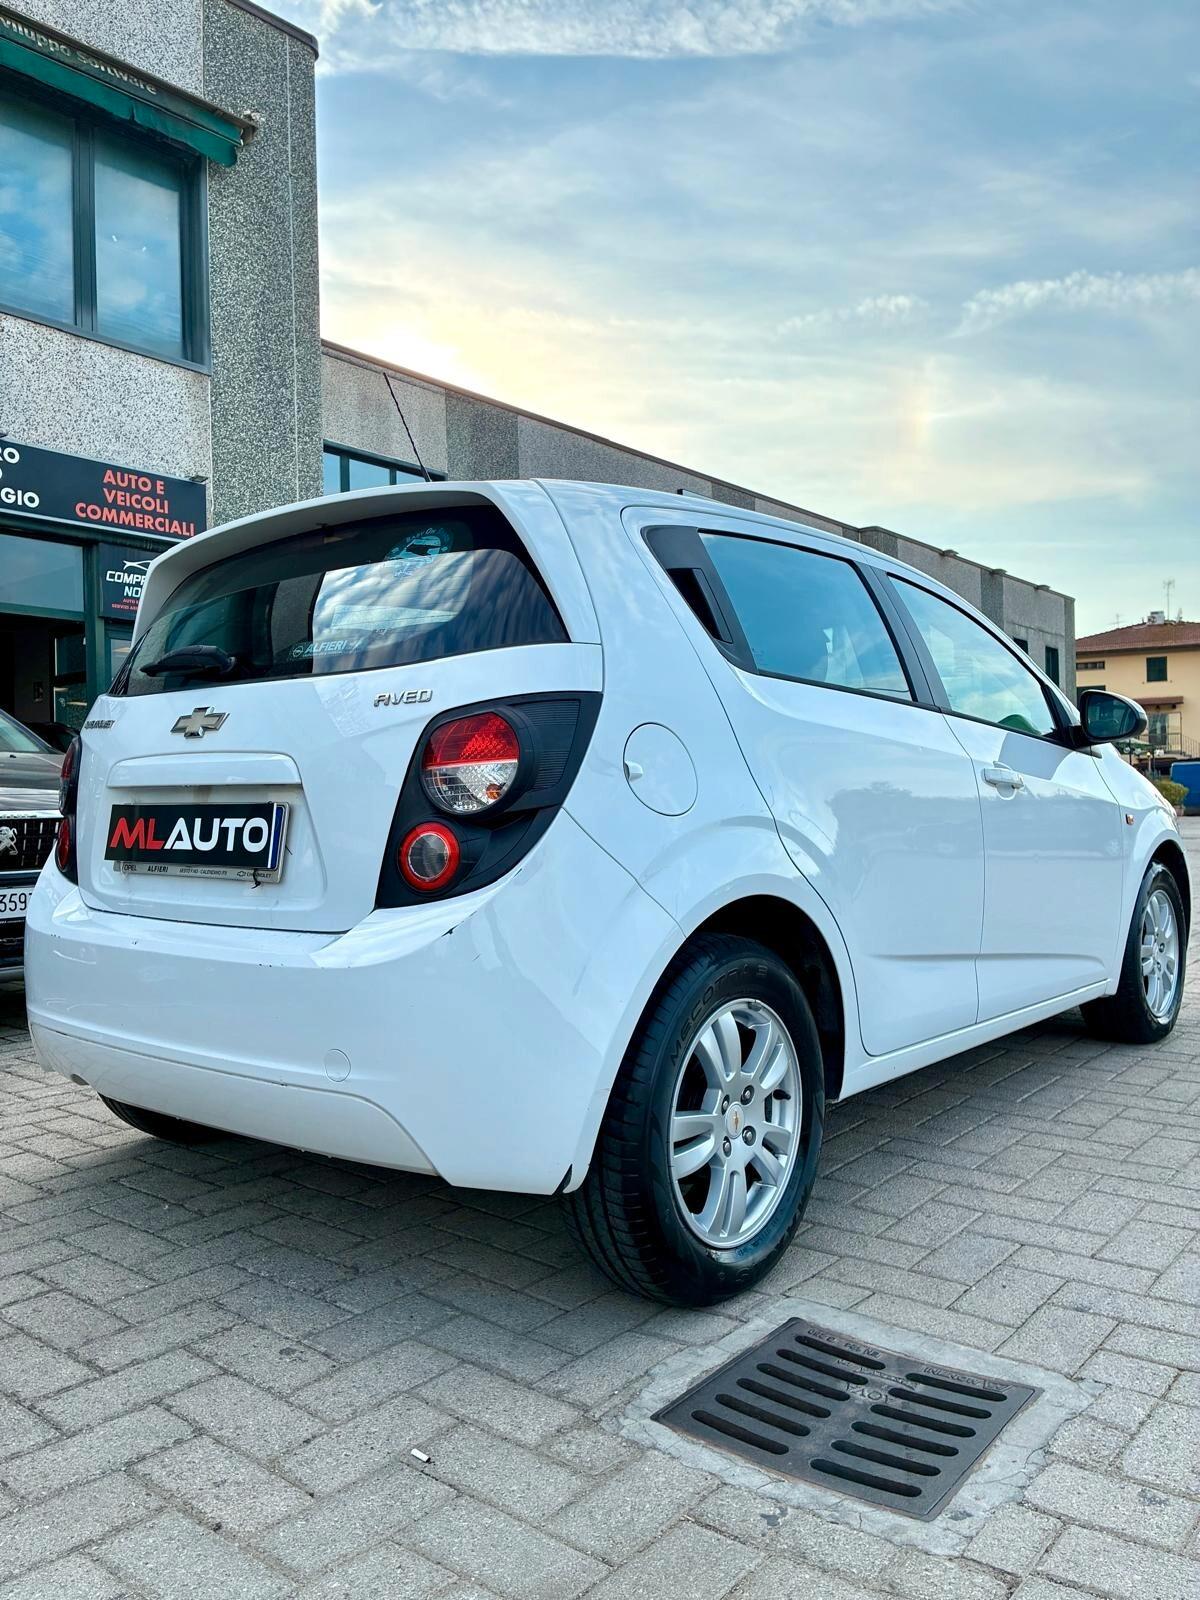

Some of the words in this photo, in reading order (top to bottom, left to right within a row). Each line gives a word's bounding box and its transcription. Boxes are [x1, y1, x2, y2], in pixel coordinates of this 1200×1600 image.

[103, 469, 151, 492] AUTO
[156, 480, 165, 495] E
[102, 488, 169, 514] VEICOLI
[75, 502, 195, 537] COMMERCIALI
[304, 640, 348, 653] ALFIERI
[373, 688, 432, 707] AVEO
[123, 863, 137, 872] OPEL
[147, 865, 169, 873] ALFIERI
[0, 892, 33, 913] 359
